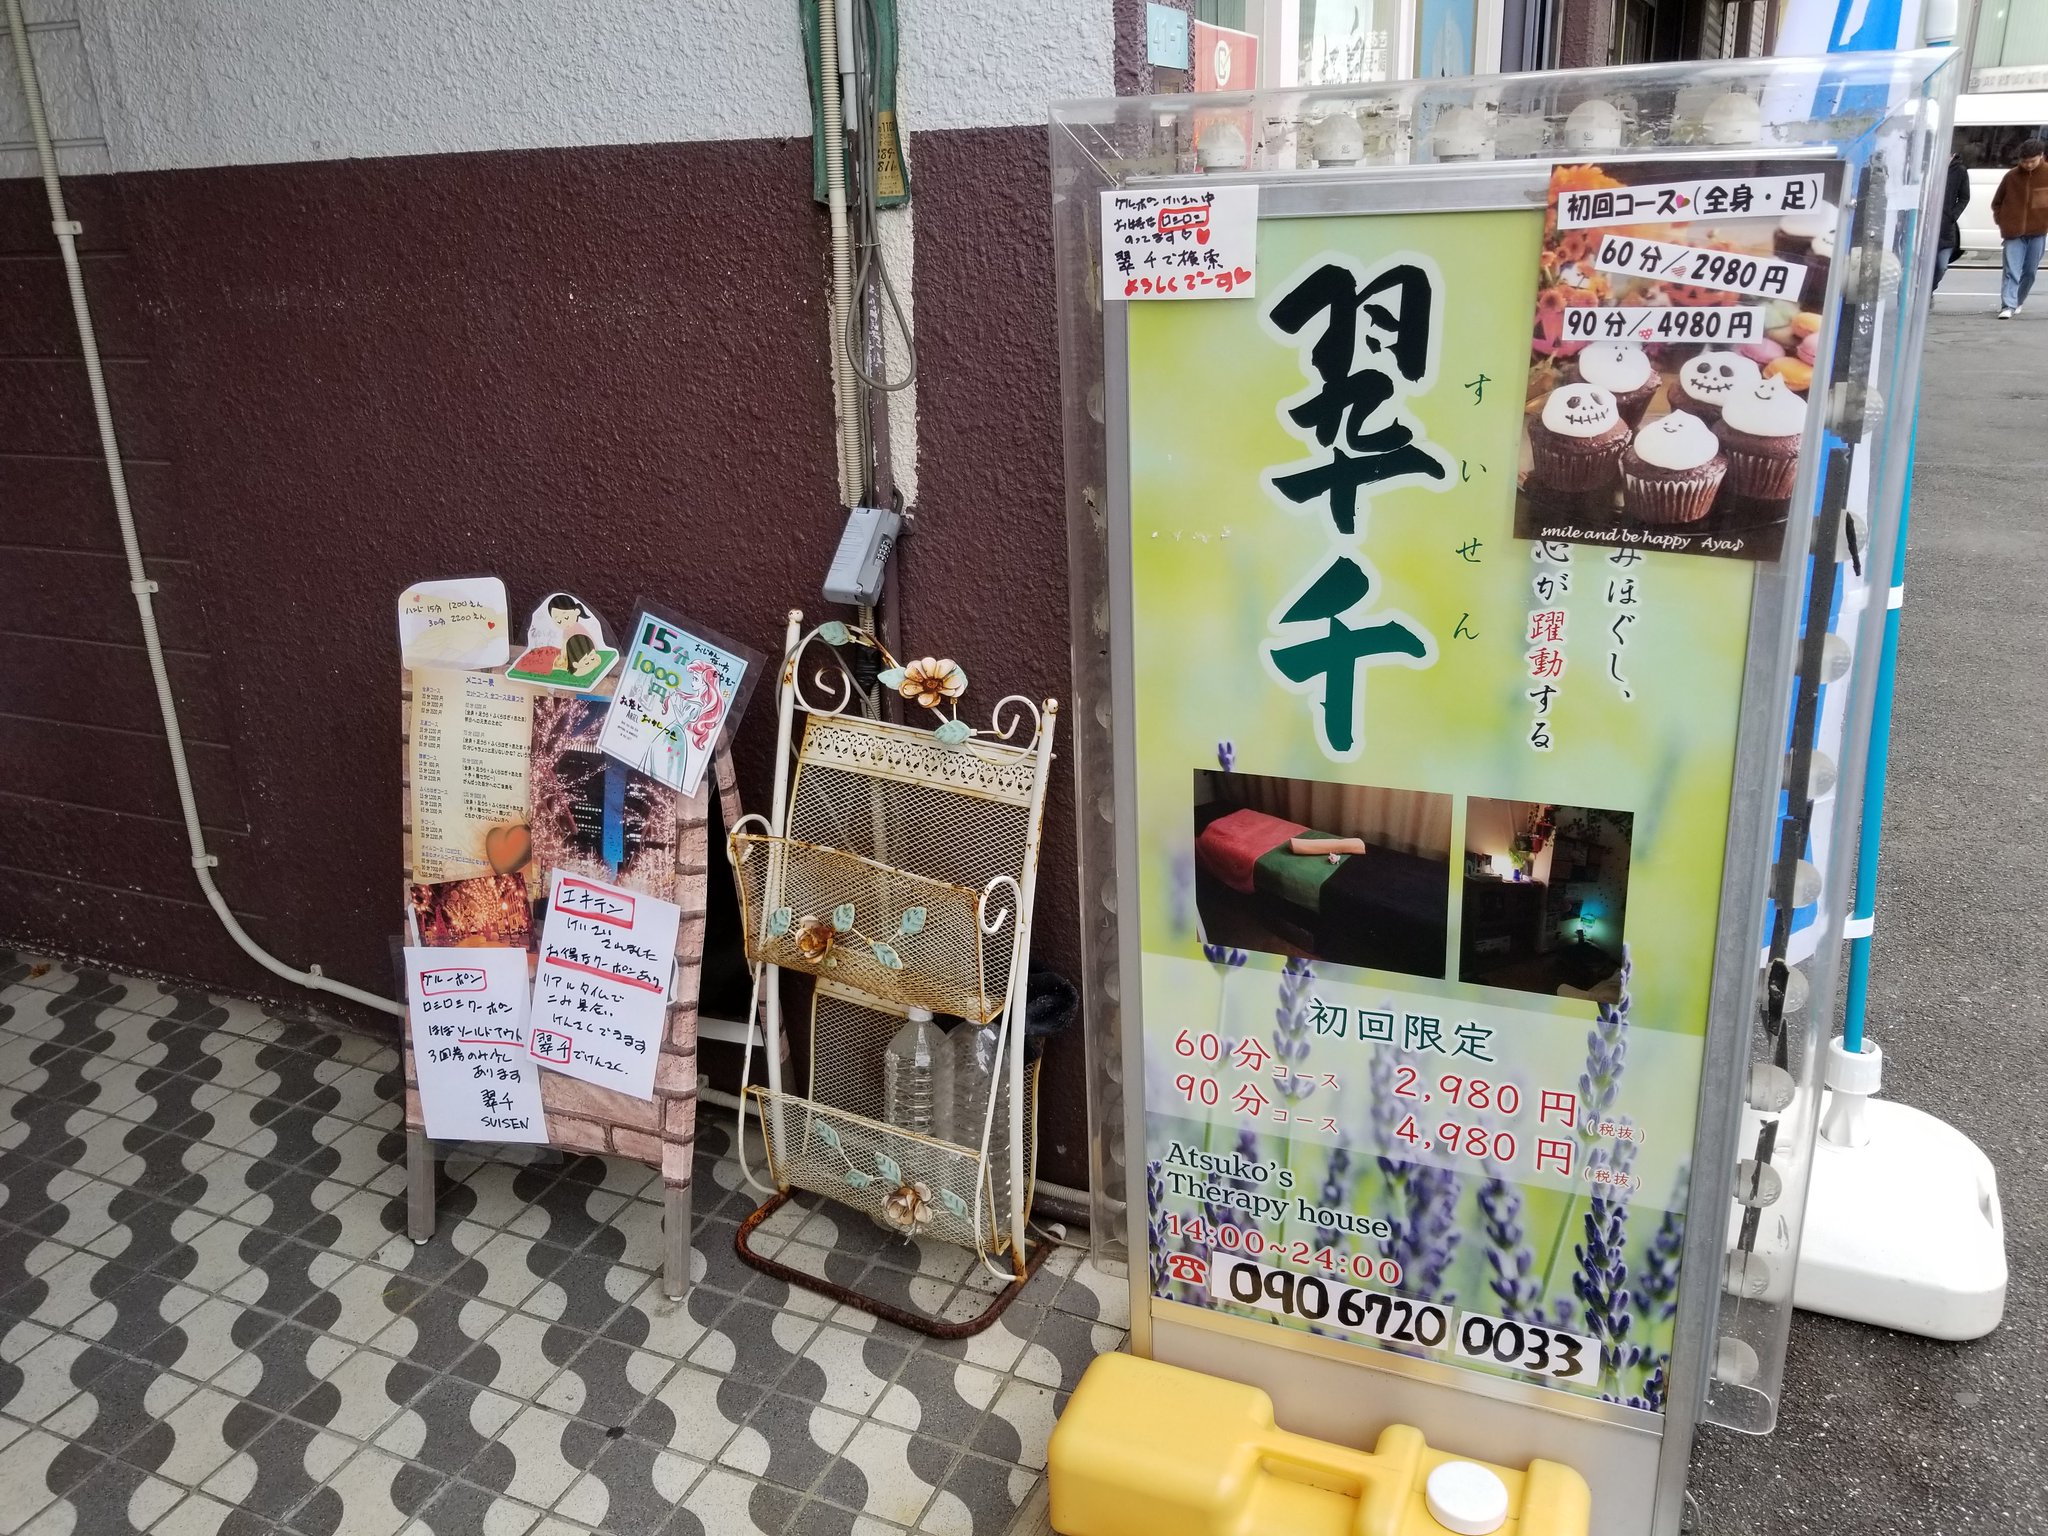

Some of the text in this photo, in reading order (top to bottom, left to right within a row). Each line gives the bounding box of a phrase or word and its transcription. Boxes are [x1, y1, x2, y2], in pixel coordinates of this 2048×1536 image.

[1568, 188, 1677, 221] 初回コース
[1269, 264, 1446, 752] 翠千
[1540, 525, 1582, 538] smile
[1584, 528, 1621, 541] and
[1622, 528, 1642, 543] be
[1642, 530, 1691, 549] happy
[562, 889, 623, 914] エキテン
[422, 971, 483, 987] グルーポン
[543, 973, 625, 1002] リアルタイムで
[1308, 997, 1494, 1063] 初回限定
[473, 1065, 521, 1083] あります
[480, 1116, 529, 1130] SUISEN
[1166, 1171, 1389, 1238] Therapy house
[1462, 1316, 1584, 1377] 0033
